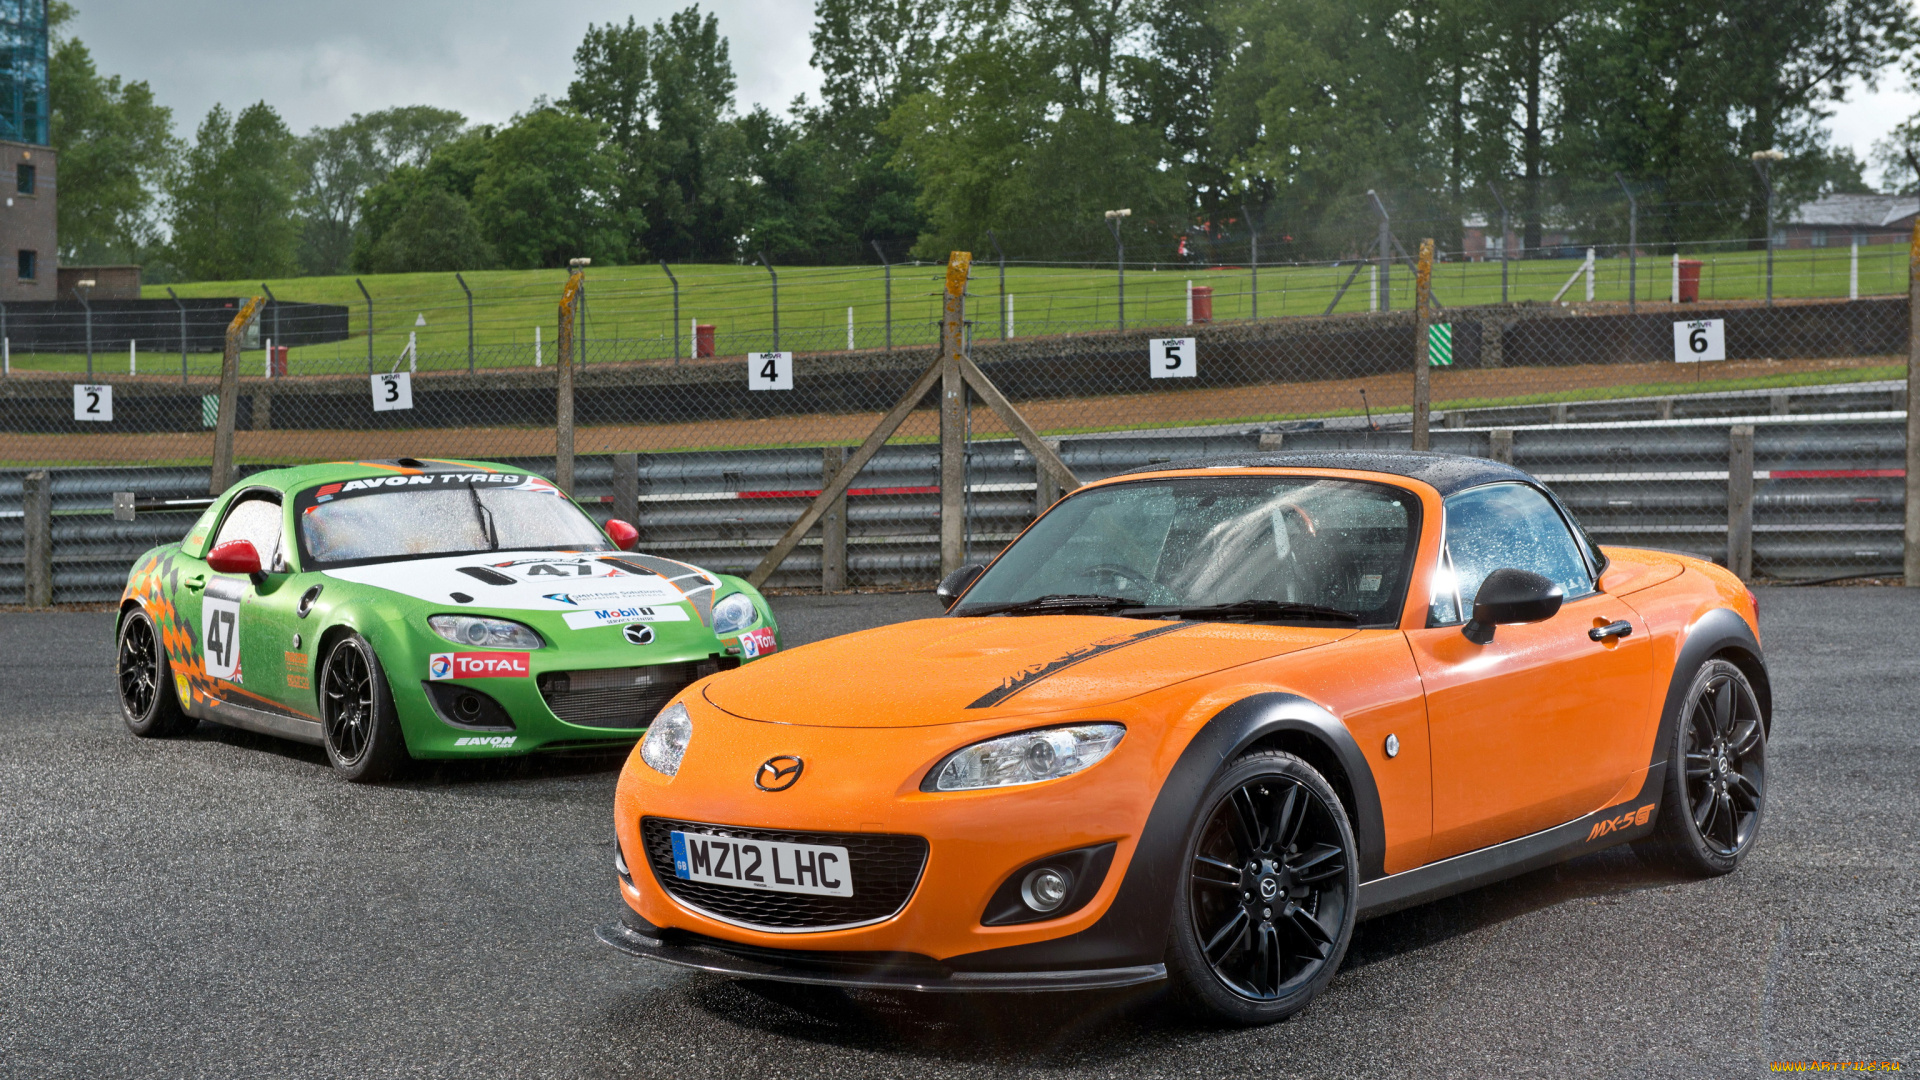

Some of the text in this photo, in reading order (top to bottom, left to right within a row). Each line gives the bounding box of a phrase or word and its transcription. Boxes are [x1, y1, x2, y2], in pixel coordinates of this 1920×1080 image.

[1689, 328, 1708, 354] 6
[1165, 346, 1182, 370] 5
[760, 359, 778, 382] 4
[384, 380, 399, 402] 3
[86, 392, 100, 413] 2
[341, 474, 519, 492] AVON TYRES
[527, 564, 592, 576] 47
[594, 607, 640, 619] Mobil
[207, 609, 236, 668] 47
[755, 634, 777, 649] TOTA
[456, 657, 526, 672] TOTAL
[467, 736, 518, 746] AVON
[676, 860, 687, 871] GB
[689, 838, 841, 889] MZ12 LHC
